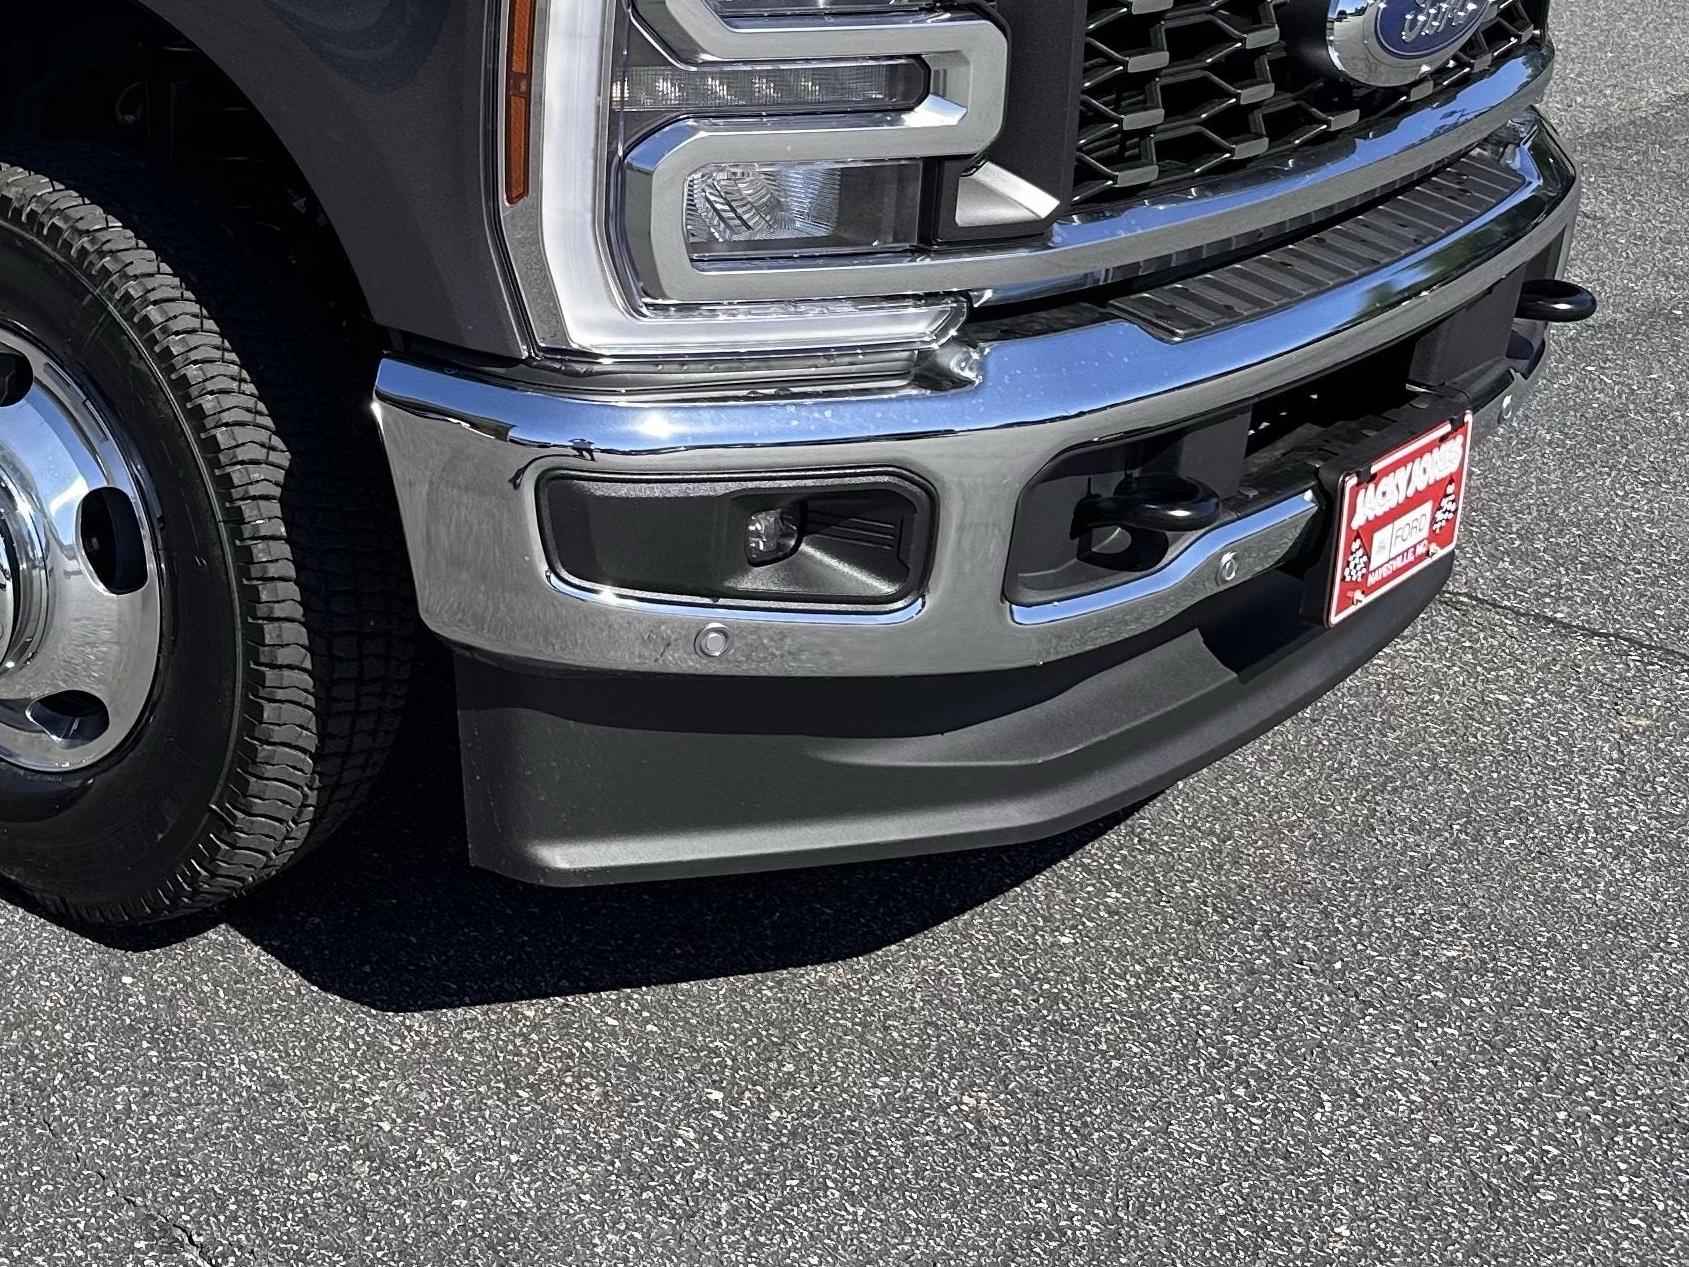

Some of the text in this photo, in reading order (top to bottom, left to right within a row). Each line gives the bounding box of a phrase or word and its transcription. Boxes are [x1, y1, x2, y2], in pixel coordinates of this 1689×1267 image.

[1350, 434, 1464, 531] JACKY JONES
[1394, 513, 1427, 547] FORD
